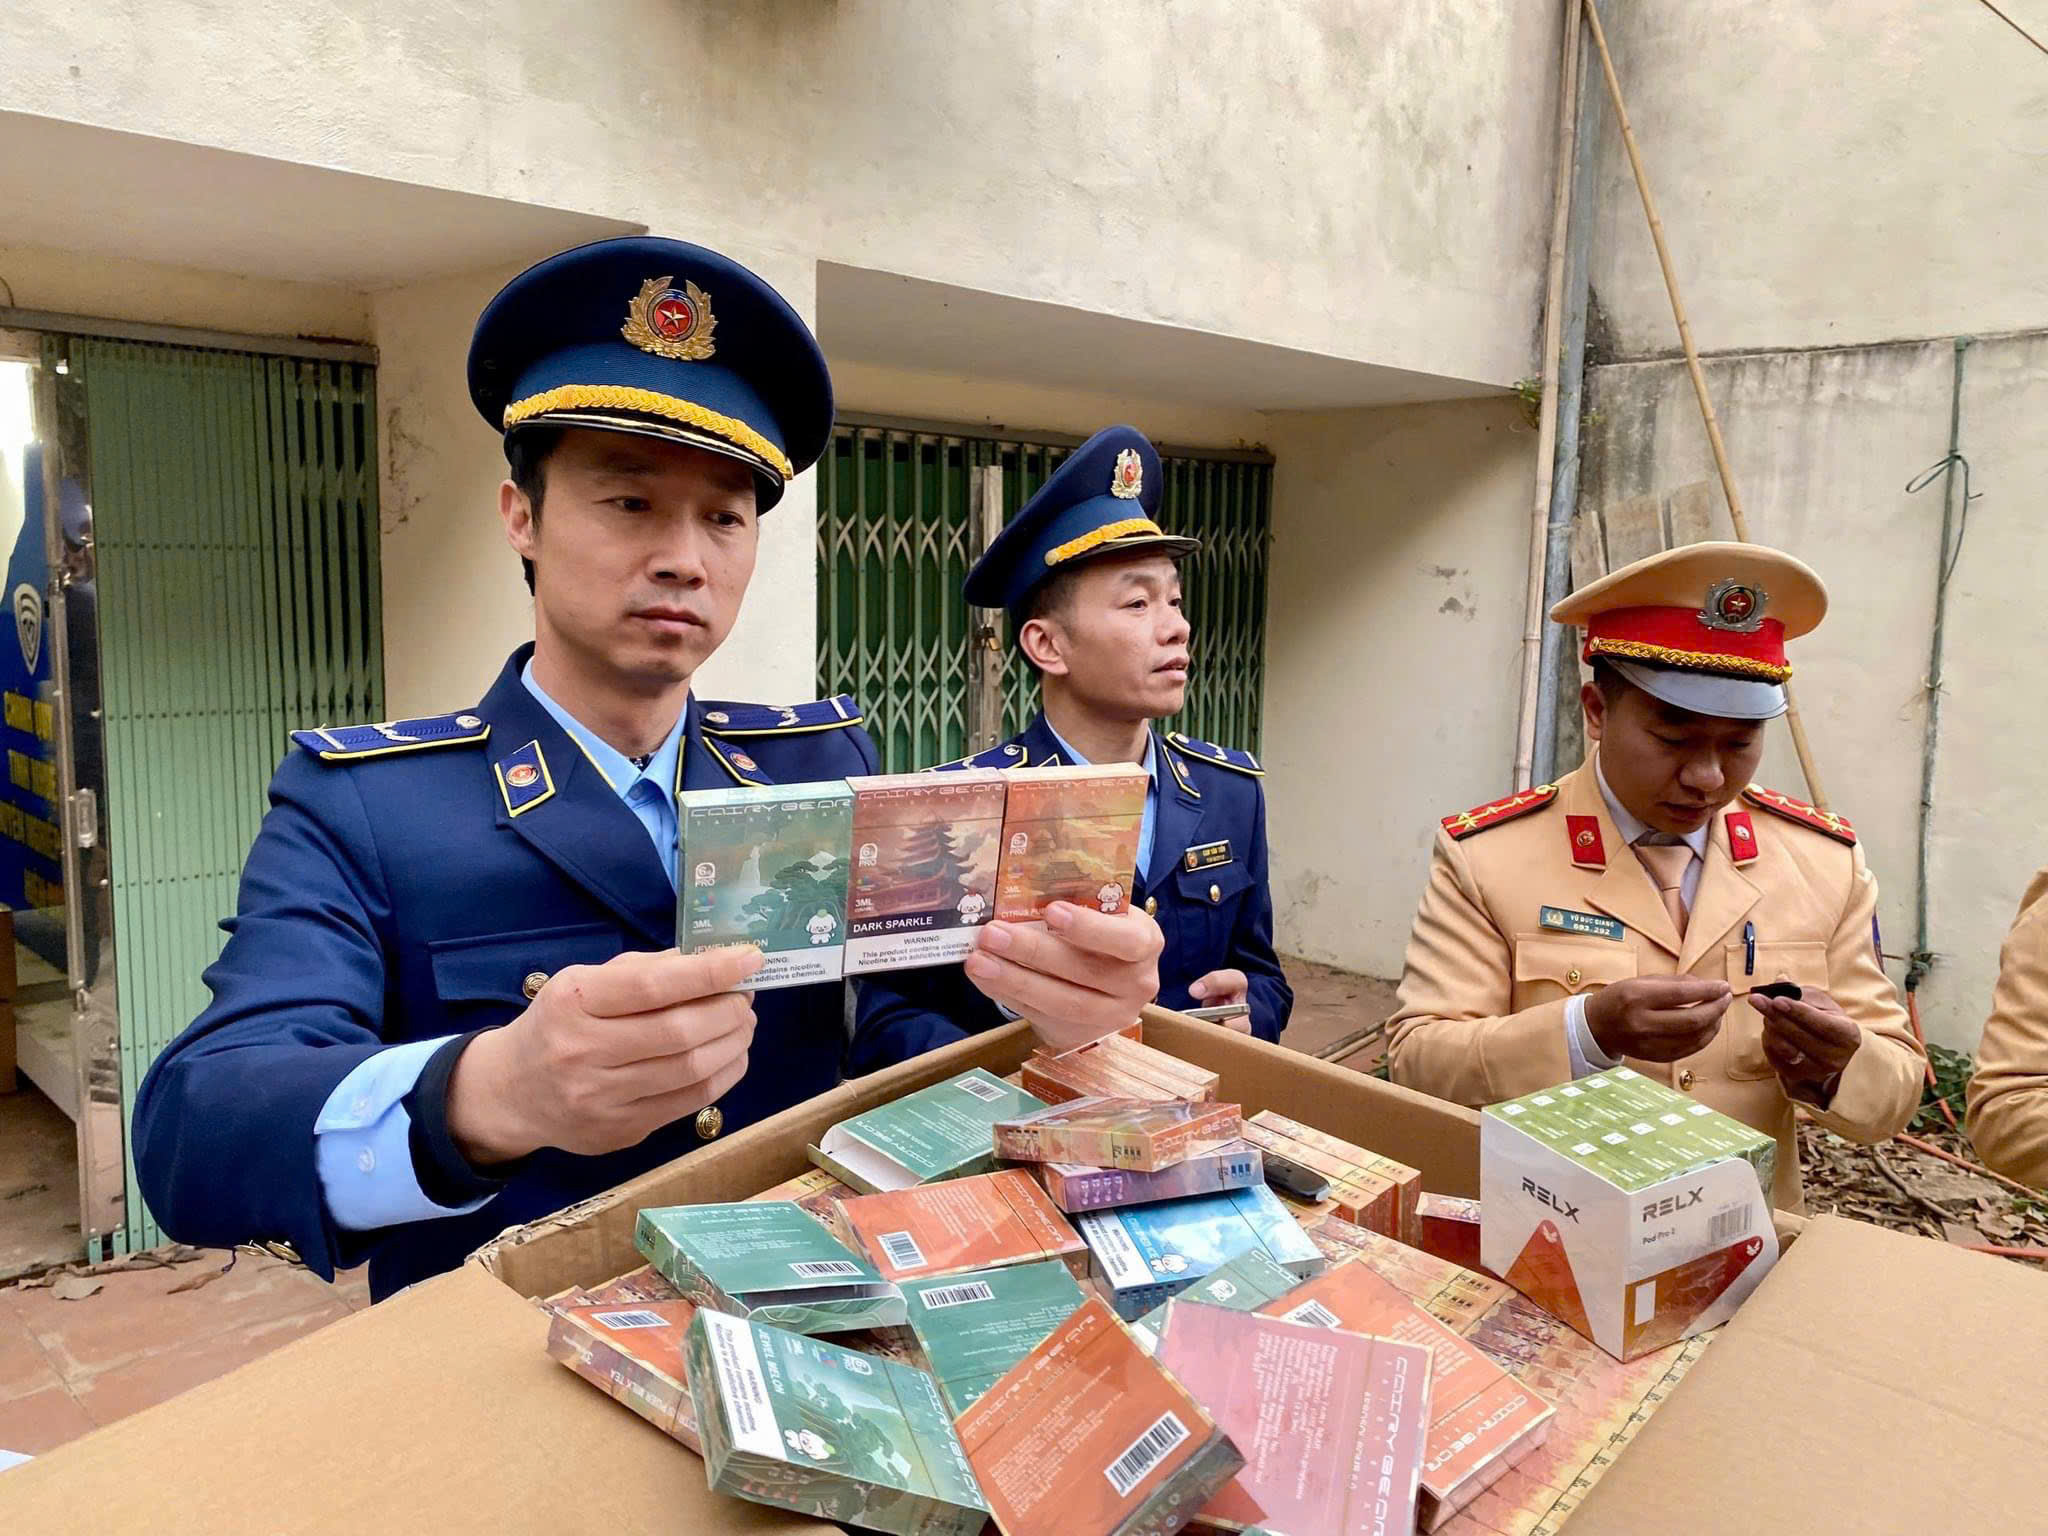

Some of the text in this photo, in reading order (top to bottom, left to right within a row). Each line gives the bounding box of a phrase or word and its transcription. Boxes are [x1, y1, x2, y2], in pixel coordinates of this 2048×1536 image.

[855, 898, 873, 907] 3ML
[853, 916, 933, 933] DARK SPARKLE
[879, 948, 907, 957] product
[909, 945, 939, 953] contains
[859, 957, 888, 966] Nicotine
[909, 951, 940, 960] addictive
[754, 973, 789, 983] addictive
[1522, 1176, 1579, 1224] RELX
[1642, 1187, 1703, 1222] RELX
[1643, 1235, 1656, 1245] Pod
